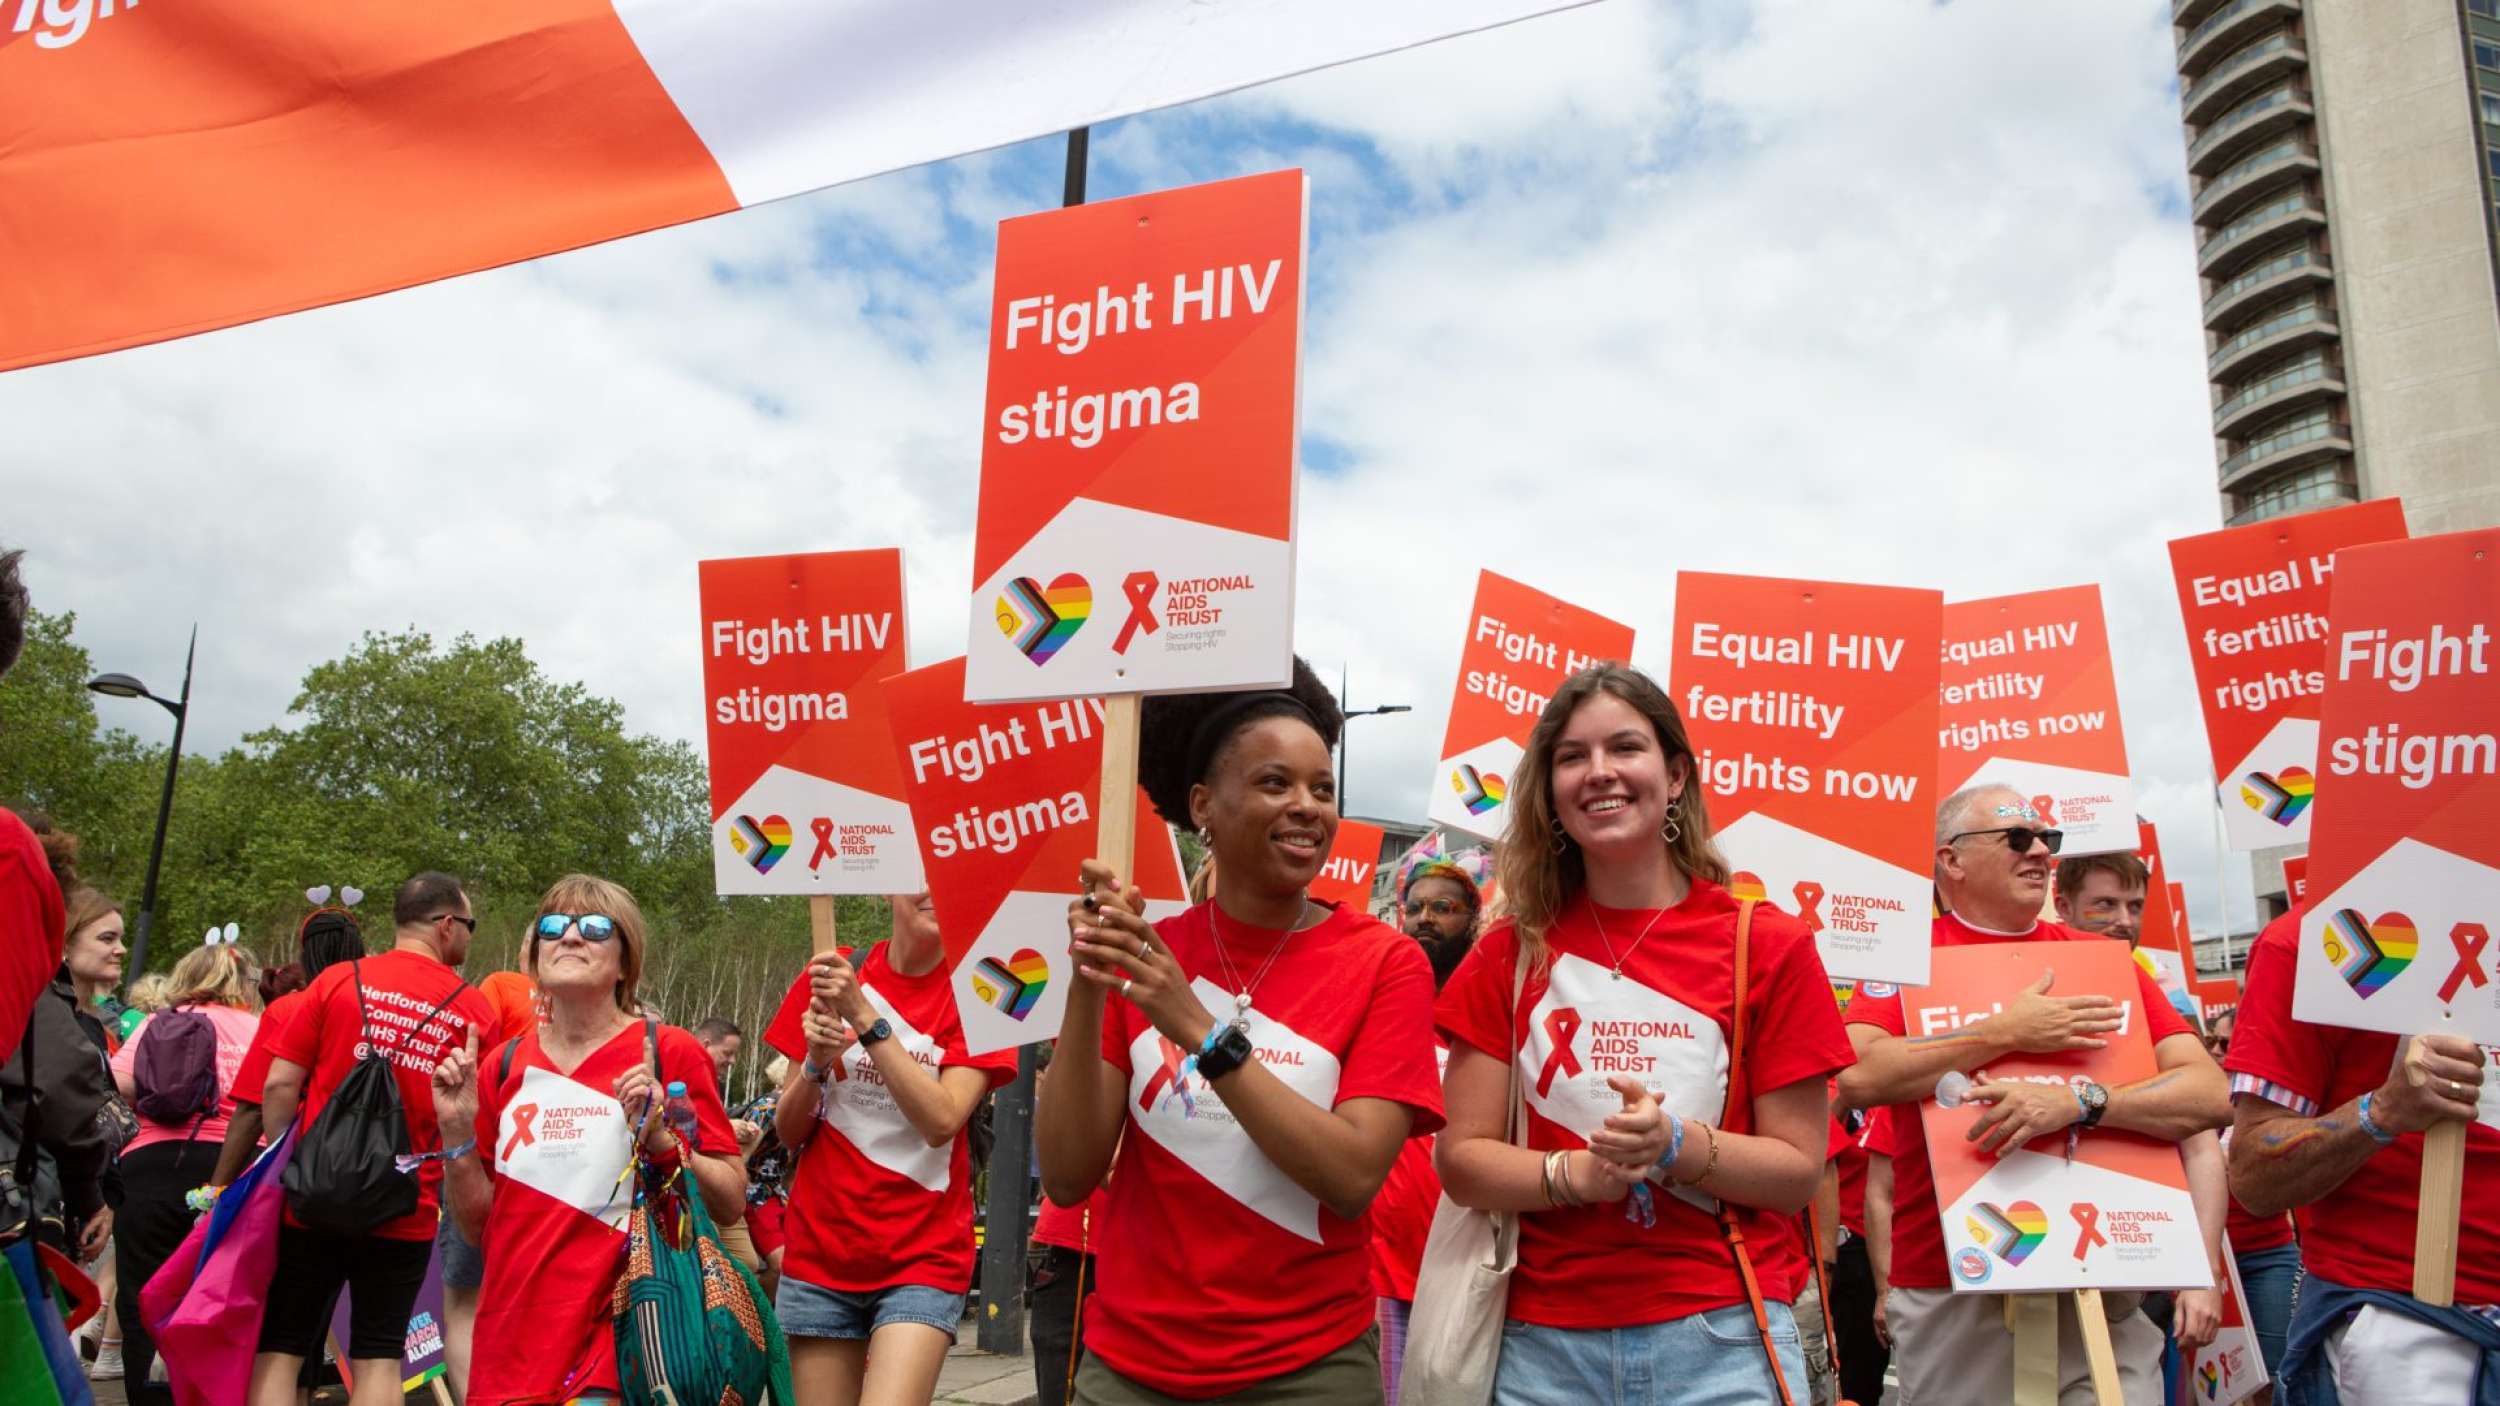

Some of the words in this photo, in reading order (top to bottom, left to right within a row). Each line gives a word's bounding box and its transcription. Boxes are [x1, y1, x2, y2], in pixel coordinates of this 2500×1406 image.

[1006, 282, 1153, 355] Fight
[1172, 259, 1282, 325] HIV
[999, 382, 1200, 449] stigma
[1167, 575, 1255, 596] NATIONAL
[2192, 560, 2301, 607] Equal
[1166, 594, 1208, 611] AIDS
[1166, 608, 1223, 627] TRUST
[712, 618, 810, 666] Fight
[821, 612, 892, 652] HIV
[1475, 615, 1558, 670] Fight
[2023, 621, 2078, 652] HIV
[1691, 622, 1813, 669] Equal
[1828, 633, 1905, 672] HIV
[2338, 624, 2491, 693] Fight
[1465, 670, 1552, 717] stigm
[2215, 668, 2325, 712] rights
[715, 686, 849, 732] stigma
[1687, 685, 1845, 739] fertility
[1939, 717, 2030, 752] rights
[2038, 710, 2105, 736] now
[909, 717, 1031, 784] Fight
[2329, 723, 2497, 789] stigm
[1695, 749, 1810, 796] ights
[1824, 767, 1918, 802] now
[2059, 795, 2113, 806] NATIONAL
[839, 825, 895, 835] NATIONAL
[930, 790, 1089, 858] stigma
[840, 835, 866, 845] AIDS
[841, 845, 876, 855] TRUST
[1320, 857, 1370, 885] HIV
[1831, 894, 1906, 912] NATIONAL
[1831, 906, 1866, 920] AIDS
[1831, 918, 1879, 933] TRUST
[361, 1023, 397, 1043] NHS
[1591, 1021, 1695, 1039] NATIONAL
[1591, 1038, 1639, 1055] AIDS
[856, 1056, 879, 1070] AI
[1252, 1048, 1304, 1065] ONAL
[1590, 1056, 1657, 1073] TRUST
[856, 1068, 886, 1087] TRU
[544, 1106, 611, 1119] NATIONAL
[543, 1118, 574, 1130] AIDS
[542, 1128, 584, 1141] TRUST
[2106, 1211, 2174, 1222] NATIONAL
[2110, 1221, 2141, 1233] AIDS
[2111, 1232, 2153, 1244] TRUST
[407, 1336, 444, 1363] ALONE
